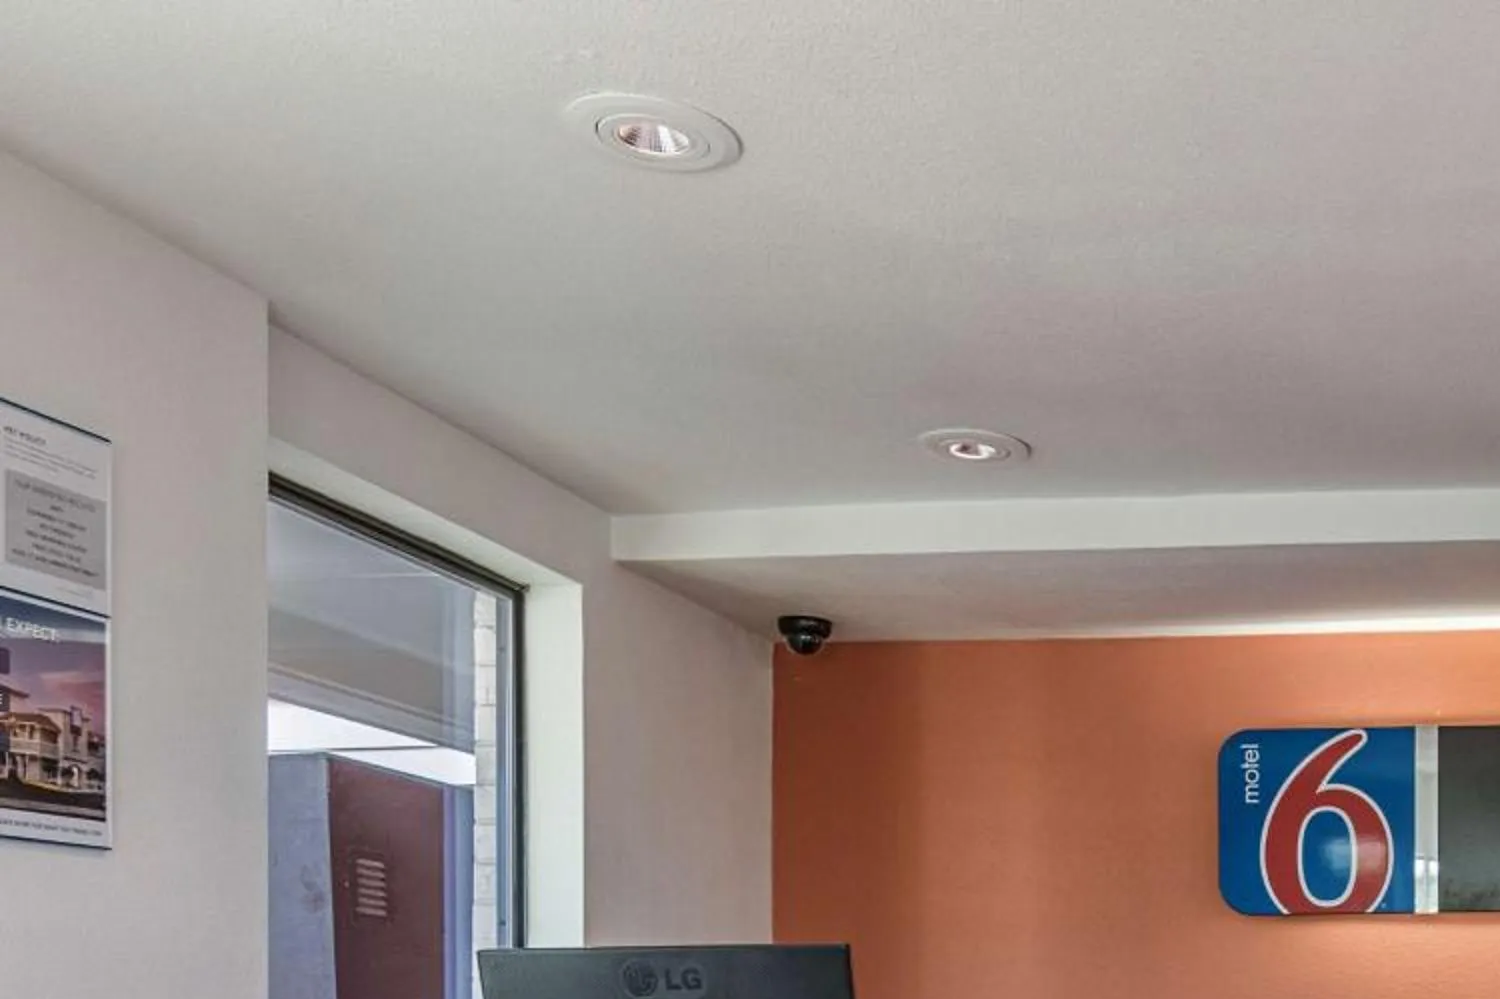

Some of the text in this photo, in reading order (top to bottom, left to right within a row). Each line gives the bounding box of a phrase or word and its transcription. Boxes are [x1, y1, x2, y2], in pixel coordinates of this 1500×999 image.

[1240, 743, 1260, 804] motel
[1259, 728, 1394, 914] 6
[664, 968, 703, 990] LG
